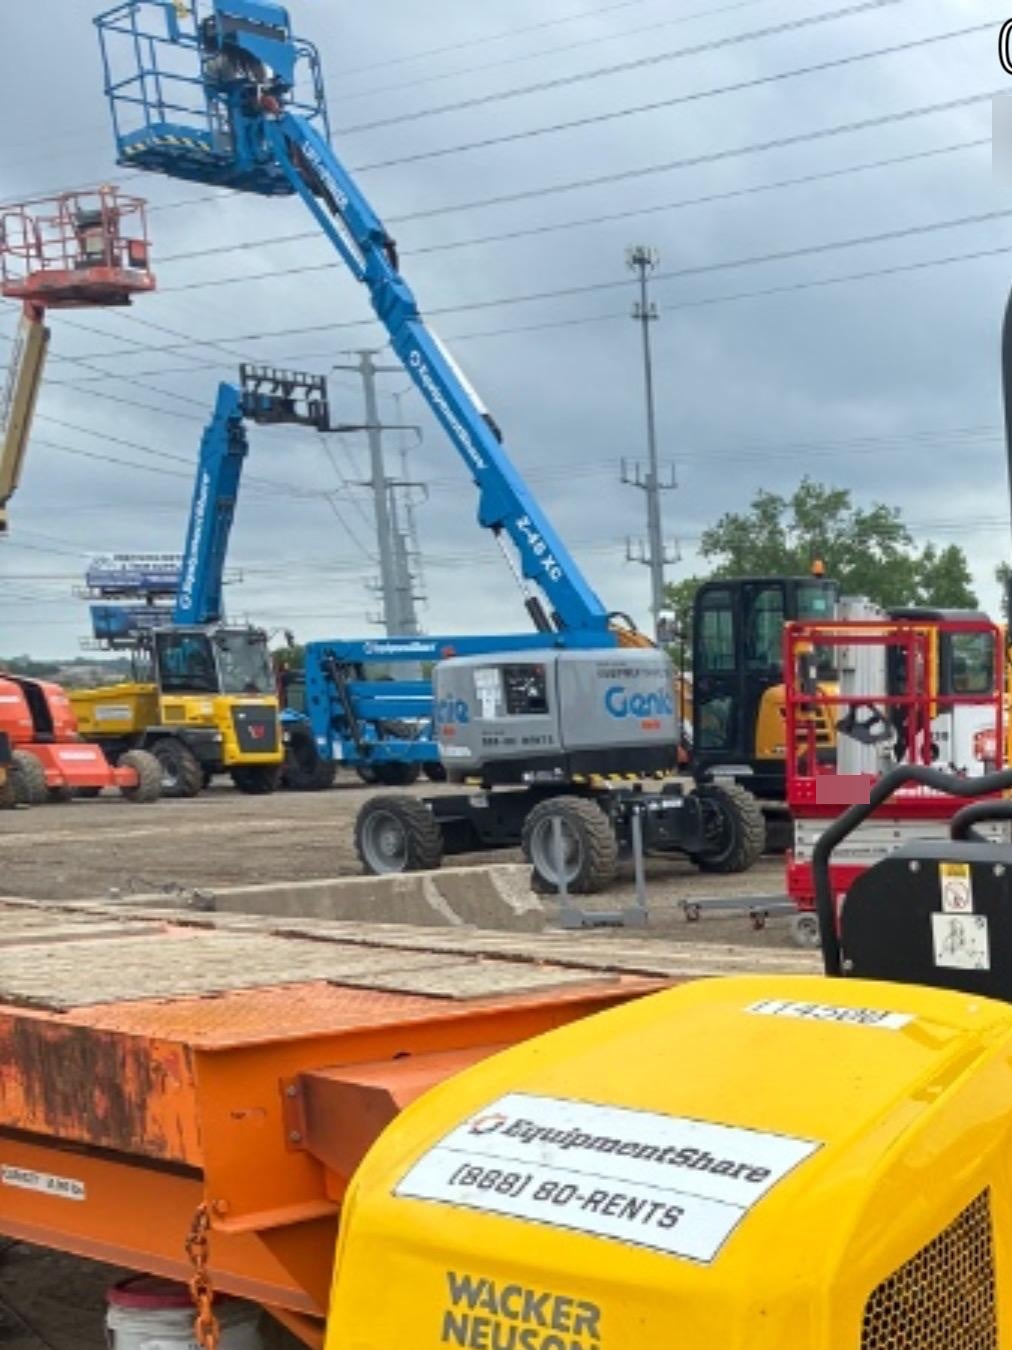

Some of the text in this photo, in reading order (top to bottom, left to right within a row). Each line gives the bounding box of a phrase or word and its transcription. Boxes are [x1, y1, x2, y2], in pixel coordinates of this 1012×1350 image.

[541, 553, 562, 582] XC
[502, 1117, 772, 1184] EquipmentShare
[447, 1162, 685, 1230] (888) 80-RENTS
[446, 1270, 601, 1341] WACKER
